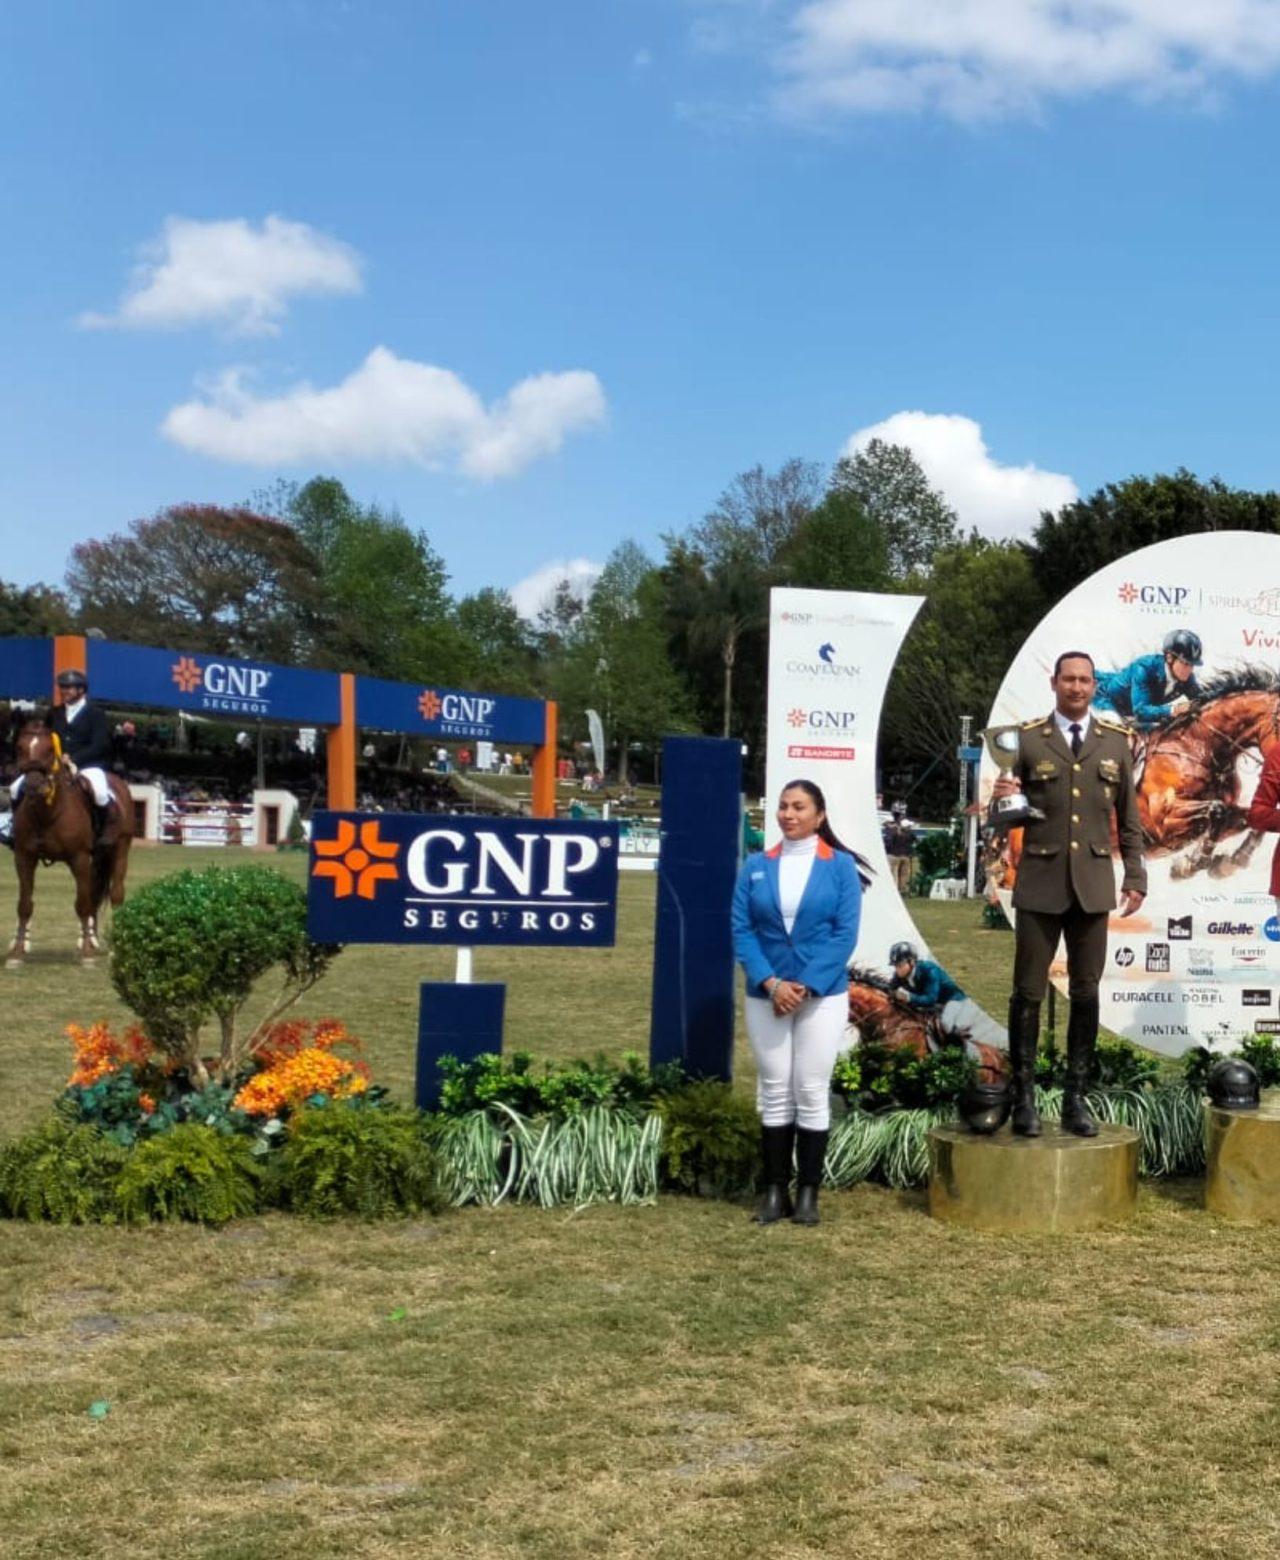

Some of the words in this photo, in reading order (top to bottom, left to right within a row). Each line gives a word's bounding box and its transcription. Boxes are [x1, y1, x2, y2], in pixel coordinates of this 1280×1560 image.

[1140, 585, 1187, 605] GNP
[204, 663, 271, 697] GNP
[202, 698, 268, 713] SEGUROS
[441, 694, 495, 722] GNP
[809, 710, 855, 728] GNP
[406, 829, 612, 897] GNP
[1207, 921, 1254, 936] Gillette
[1112, 992, 1174, 1004] DURACELL
[1182, 993, 1225, 1004] DOBEL
